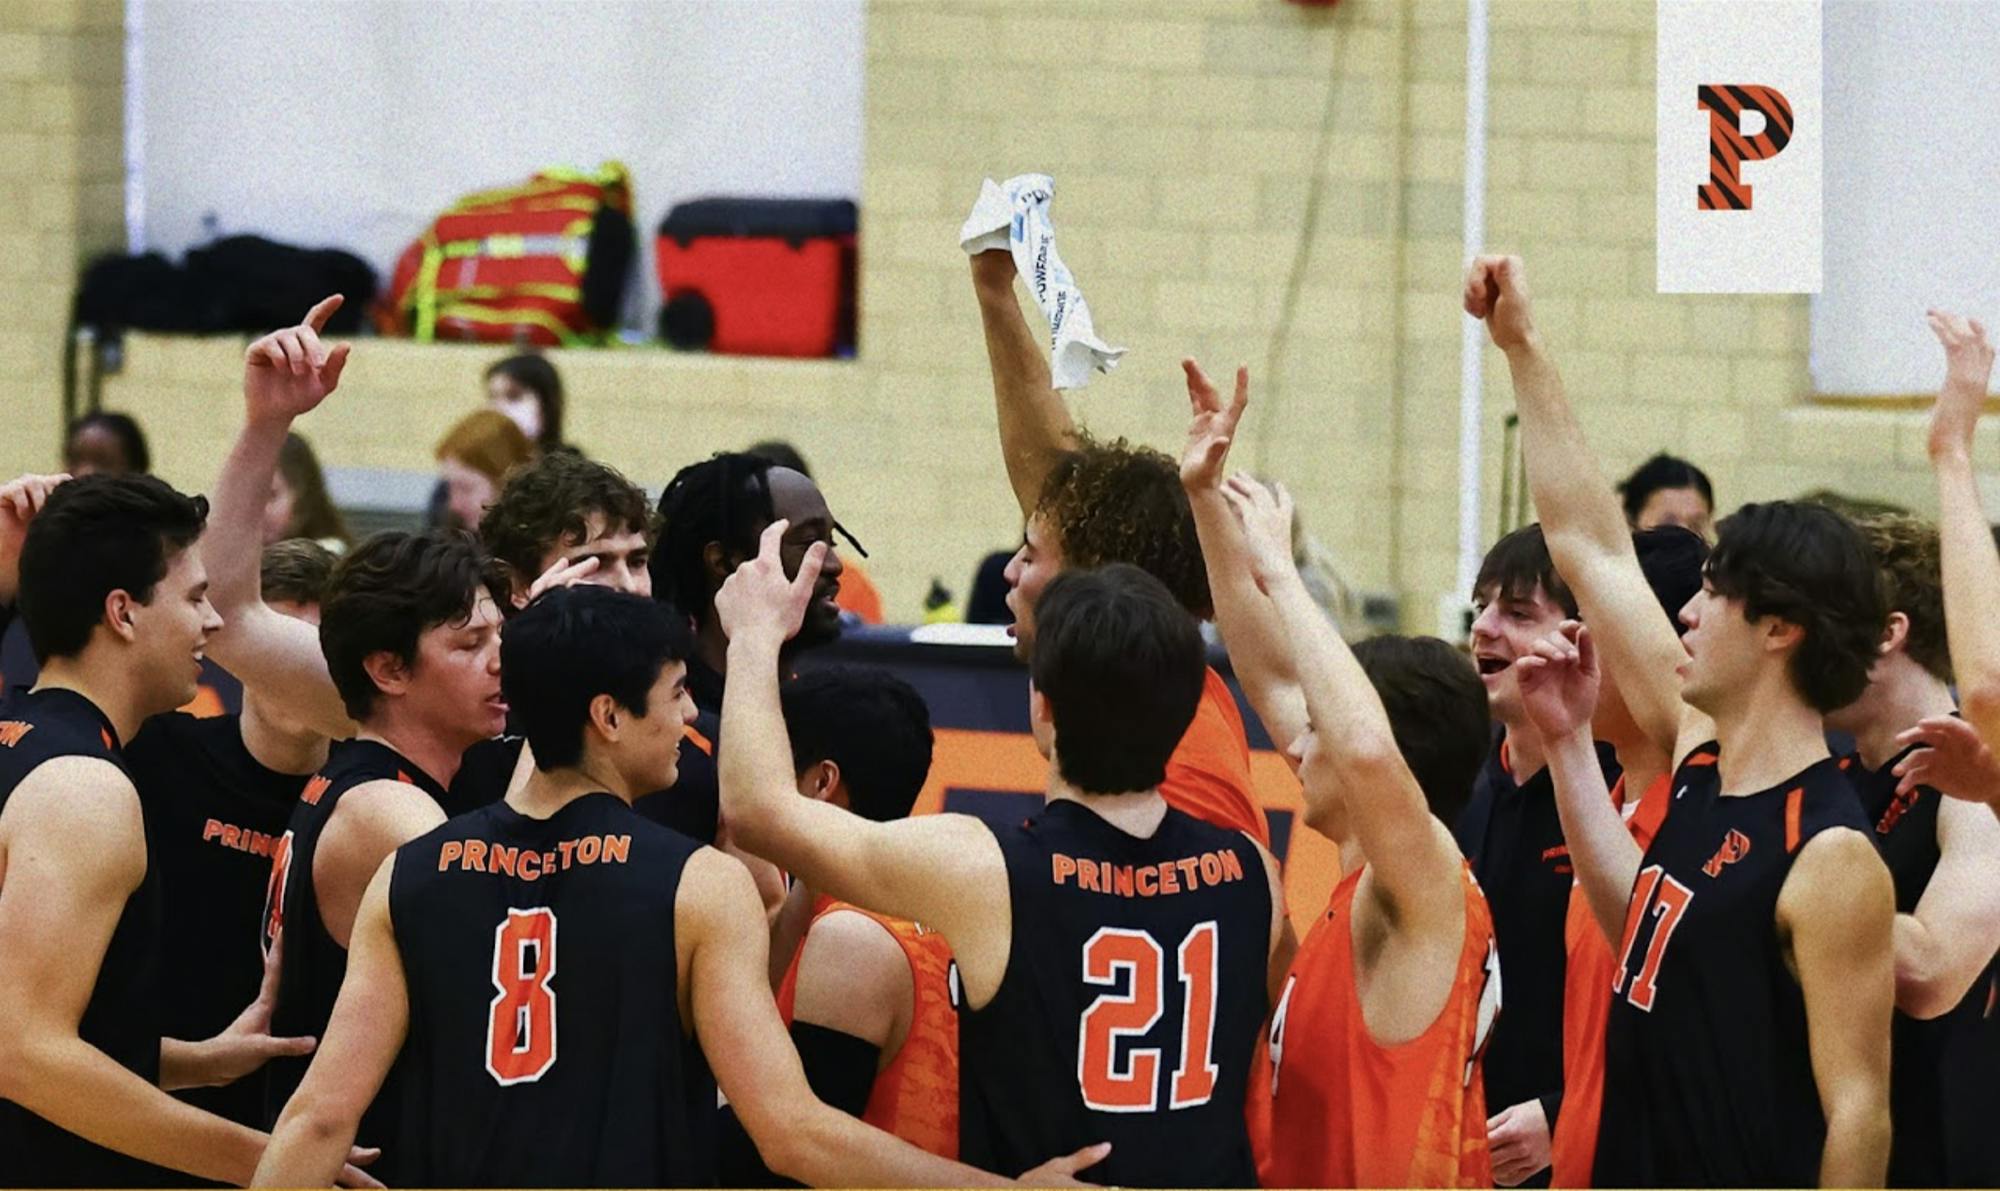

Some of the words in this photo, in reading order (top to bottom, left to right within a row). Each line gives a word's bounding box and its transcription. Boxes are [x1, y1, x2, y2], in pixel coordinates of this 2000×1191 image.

[438, 834, 632, 881] PRNCETON
[1052, 849, 1244, 898] PRINCETON
[1701, 828, 1751, 879] P
[1612, 864, 1695, 1013] 17
[485, 906, 557, 1087] 8
[1077, 920, 1219, 1113] 21
